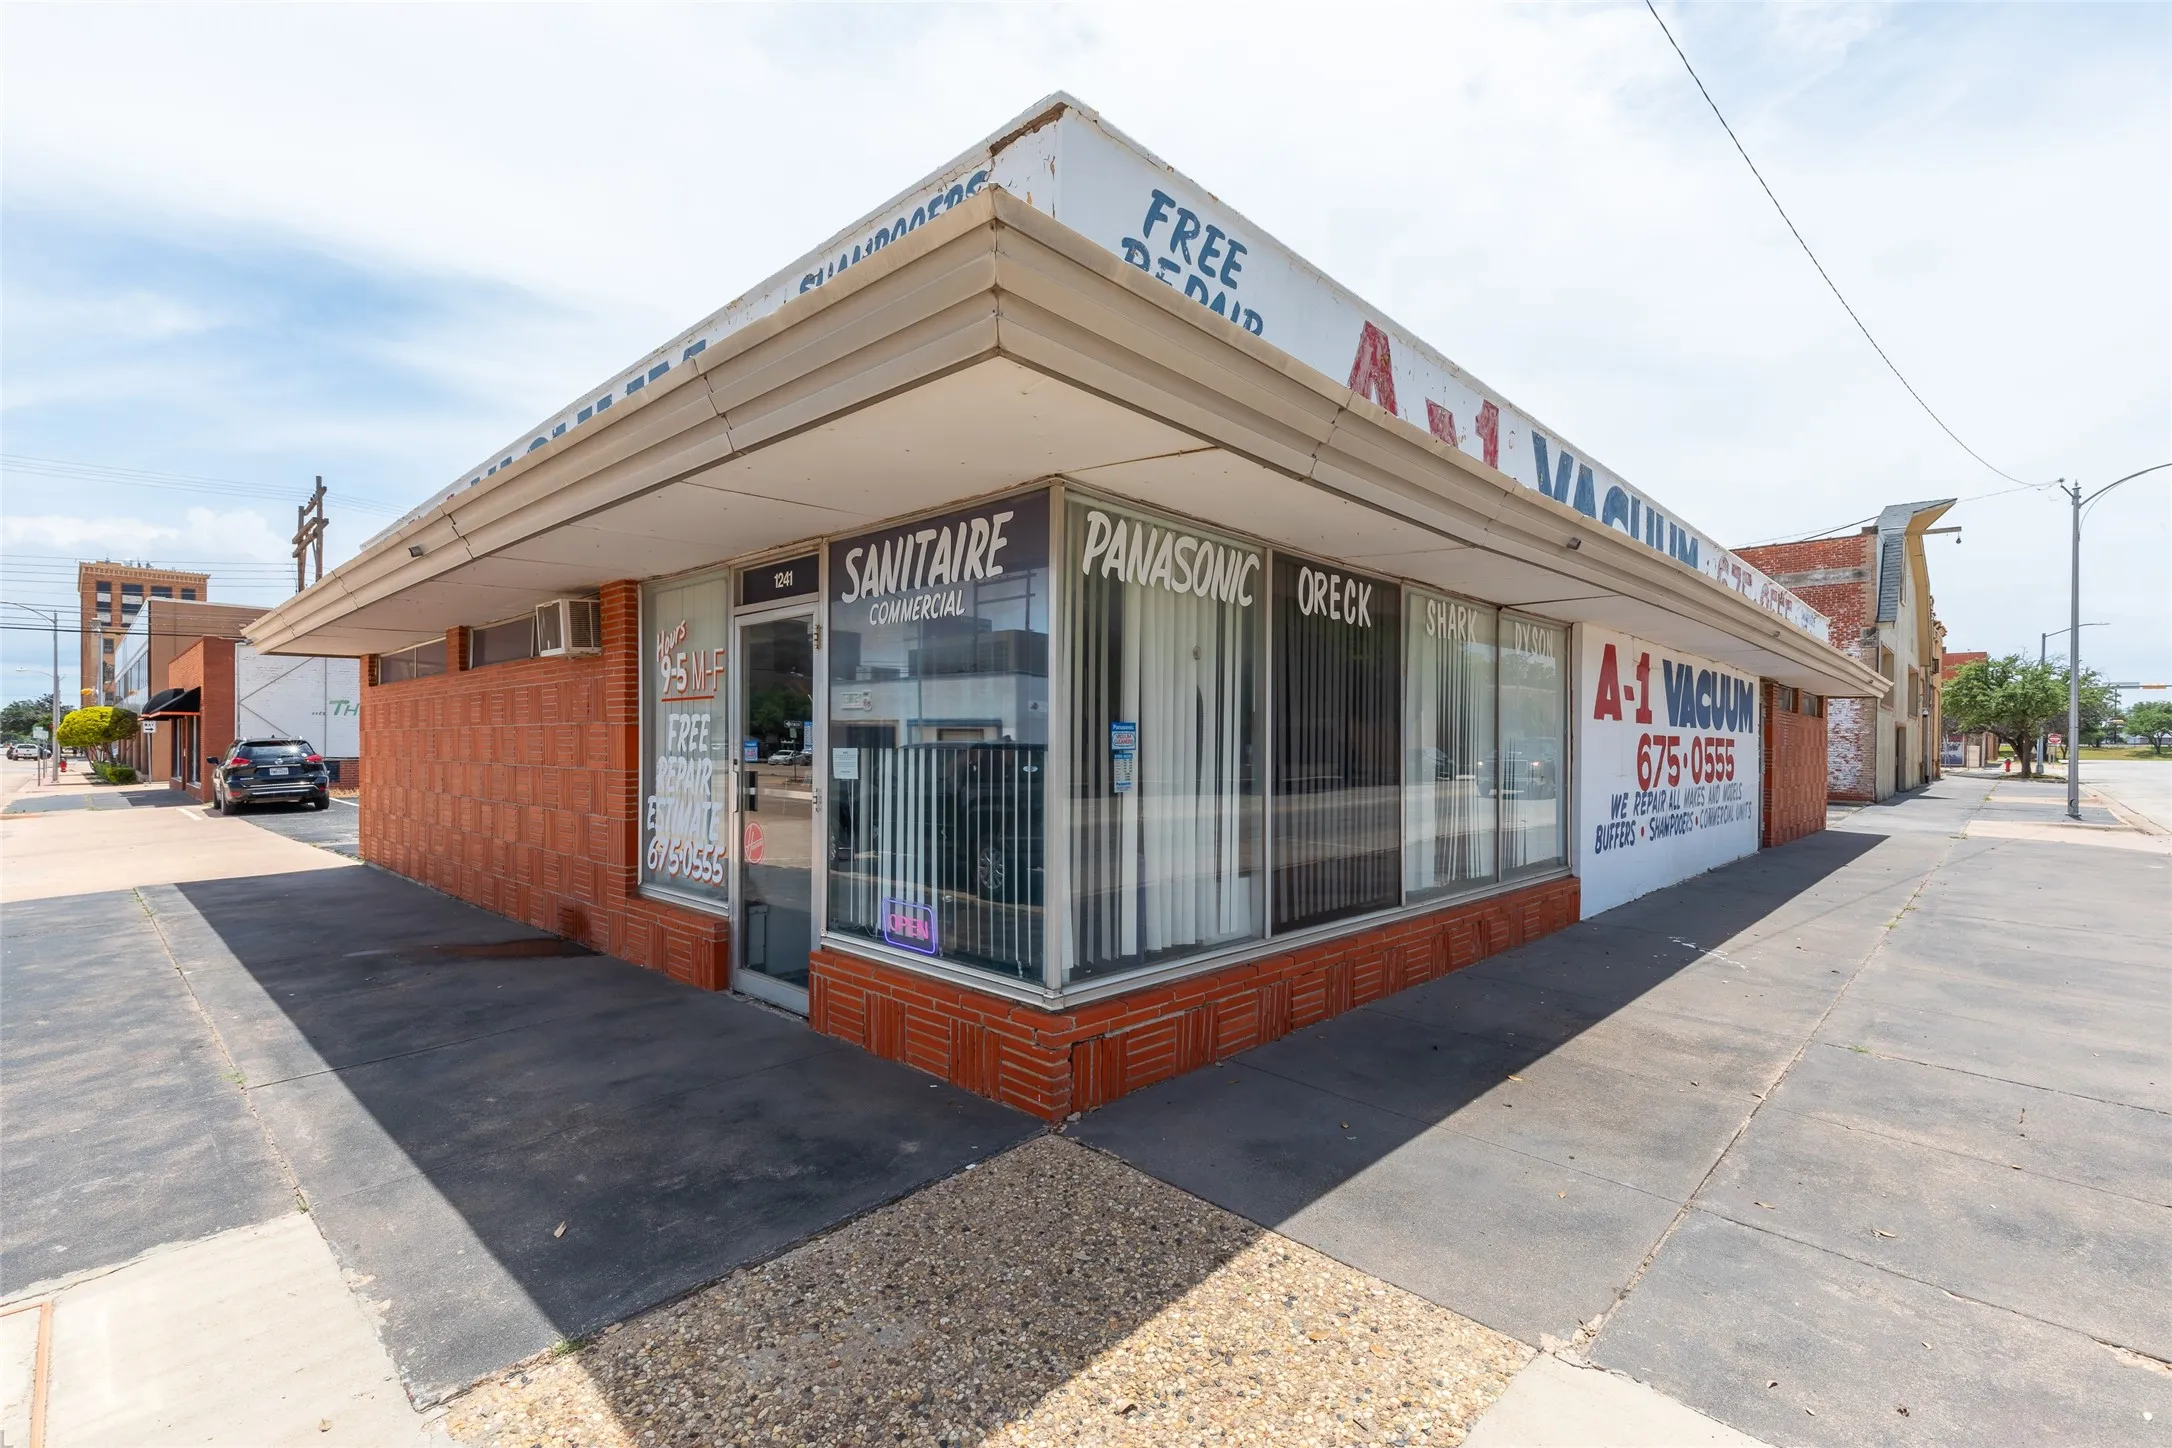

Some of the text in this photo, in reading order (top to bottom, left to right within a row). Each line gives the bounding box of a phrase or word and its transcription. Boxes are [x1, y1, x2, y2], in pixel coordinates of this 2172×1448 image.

[1143, 189, 1248, 290] FREE
[1348, 320, 1500, 470] A-1
[774, 570, 793, 588] 1241
[841, 511, 1014, 603] SANITAIRE
[1082, 510, 1260, 607] PANASONIC
[869, 589, 966, 625] COMMERCIAL
[1298, 566, 1372, 628] ORECK
[656, 619, 687, 663] Hours
[1426, 599, 1477, 643] SHARK
[1515, 622, 1553, 659] DYSON
[661, 647, 725, 694] 9-5 M-F
[1593, 643, 1754, 734] A-1 VACUUM
[668, 713, 711, 752] FREE
[655, 756, 713, 796] REPAIR
[647, 795, 723, 842] ESTIMATE
[1611, 782, 1743, 821] WE REPAIR ALL MAKES AND MODELS
[1595, 820, 1637, 855] BUFFERS
[1700, 803, 1734, 830] COMMERCIAL
[1736, 801, 1752, 822] UNITS
[888, 913, 929, 940] OPEN
